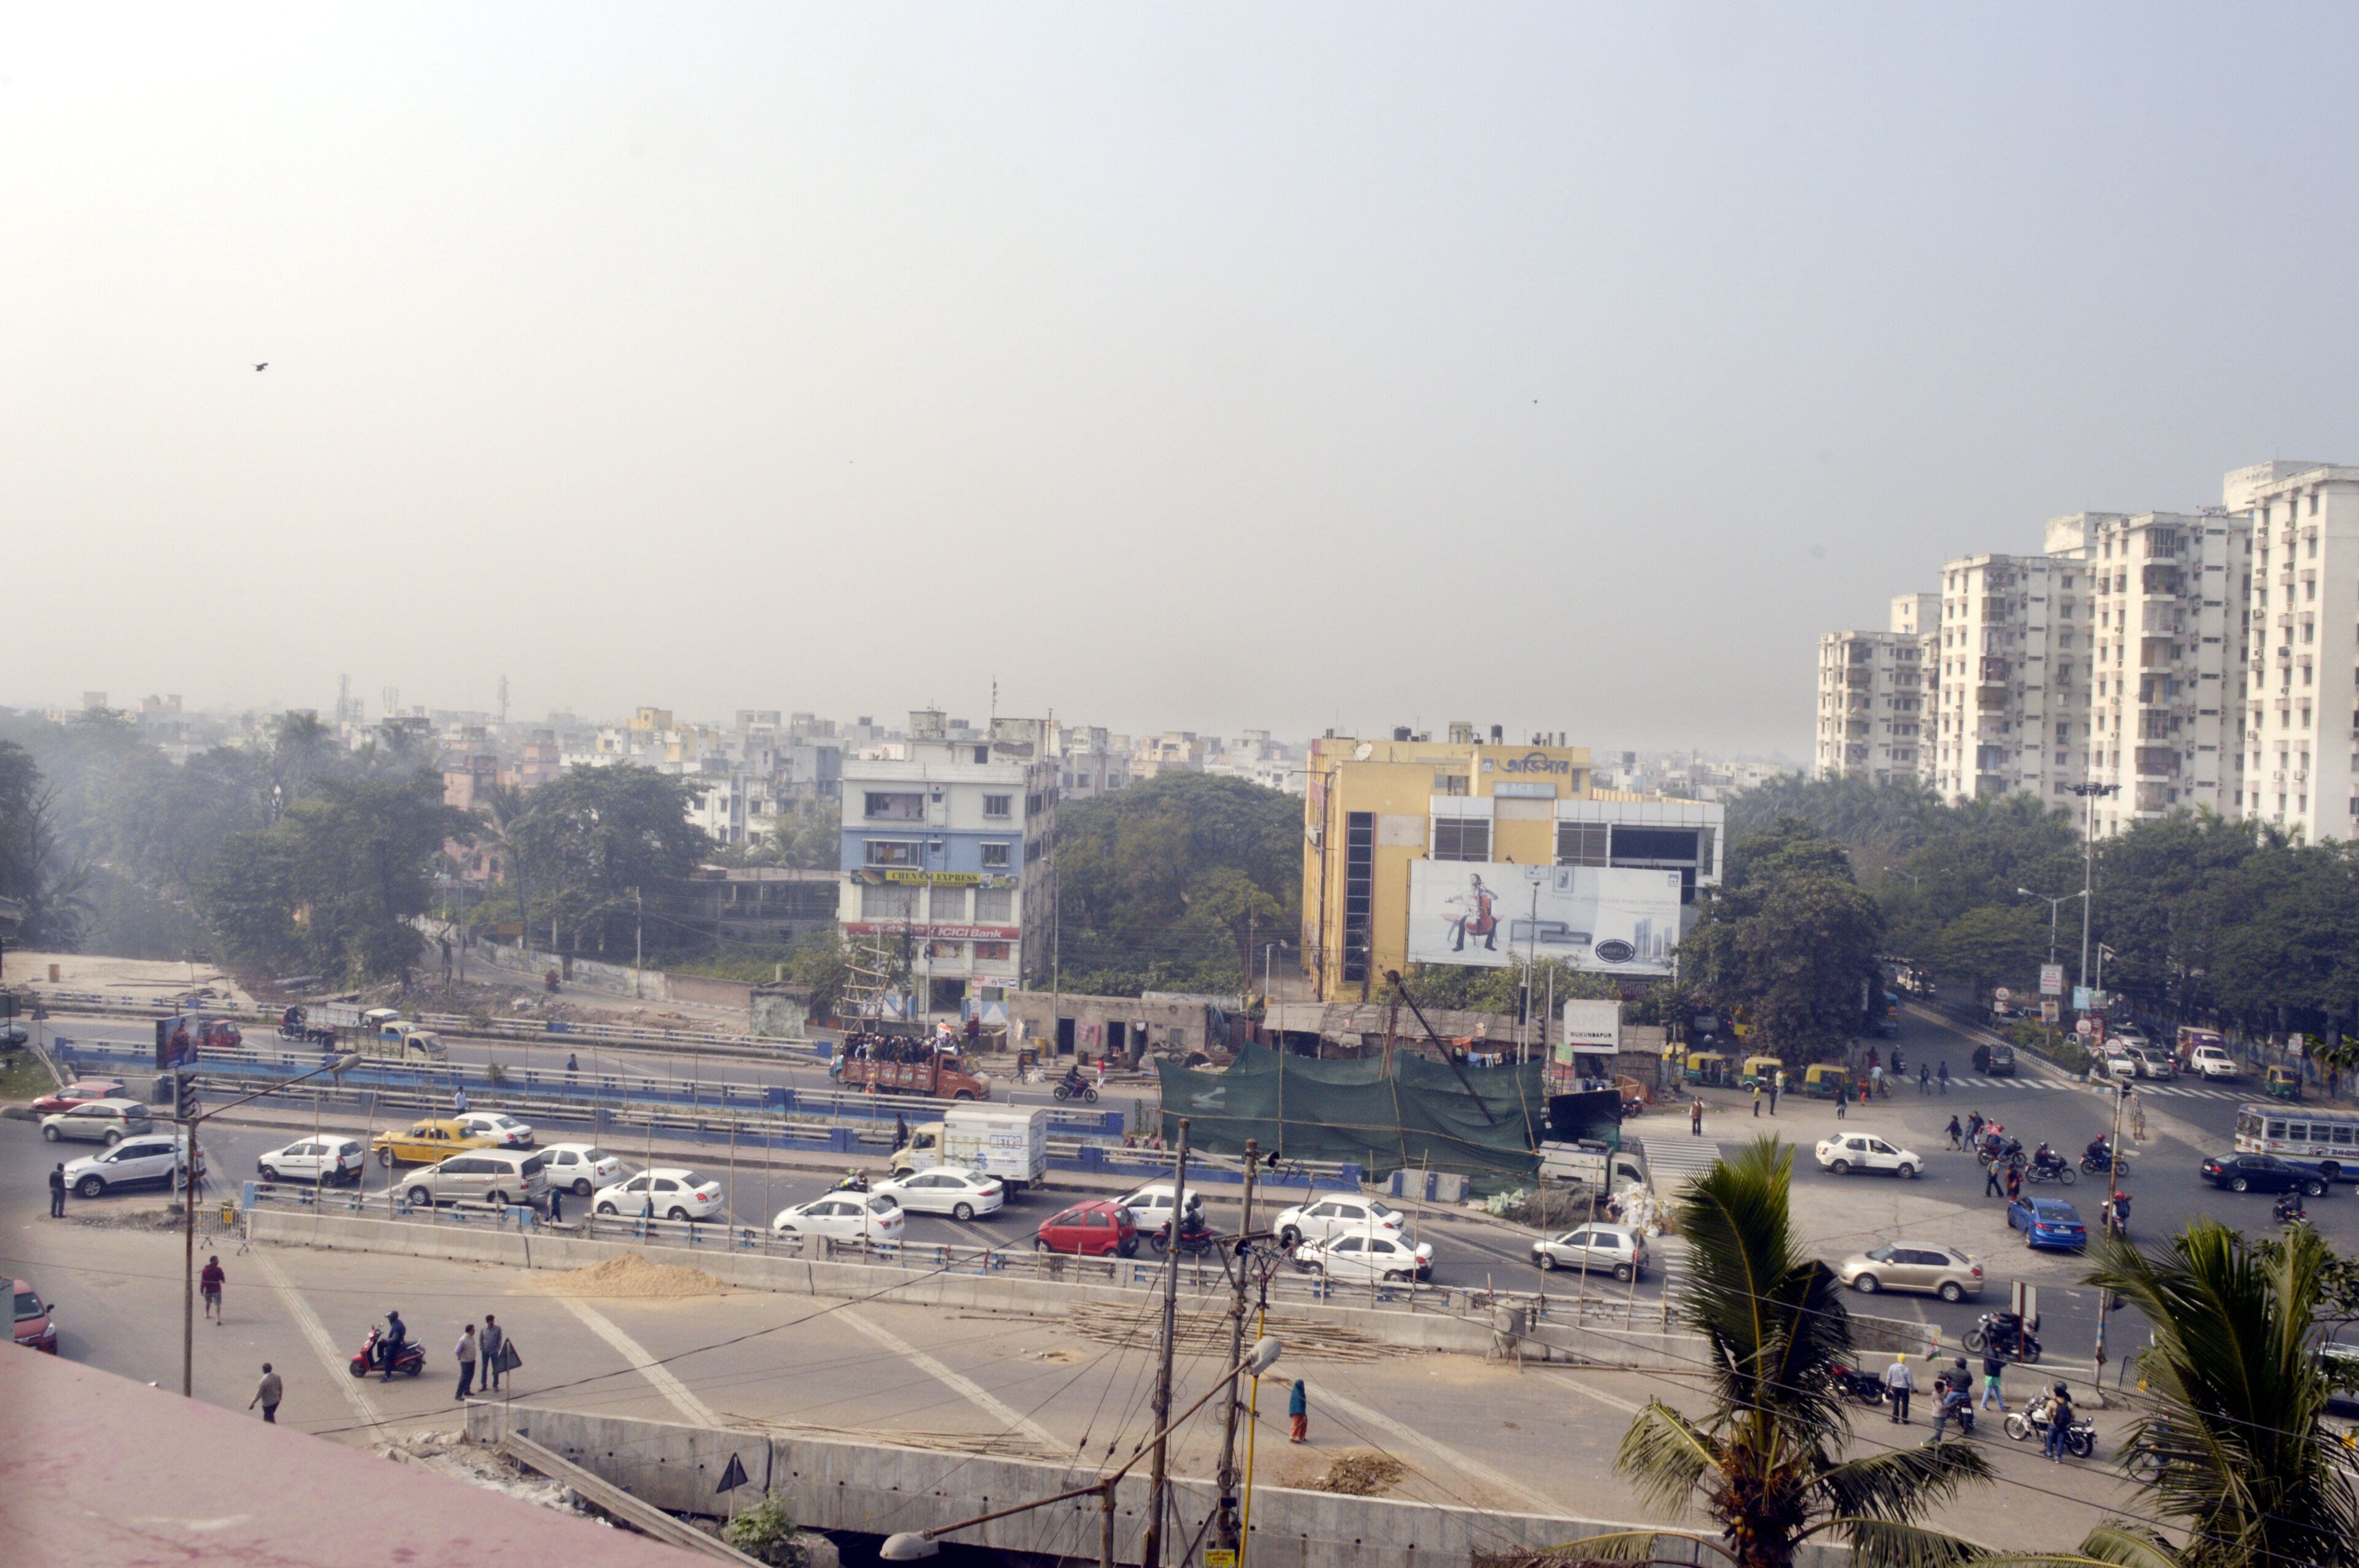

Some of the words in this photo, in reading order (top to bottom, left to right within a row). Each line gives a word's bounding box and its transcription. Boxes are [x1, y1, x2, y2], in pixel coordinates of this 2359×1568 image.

[938, 927, 969, 937] ICICI
[970, 929, 1002, 938] Bank
[989, 1134, 1022, 1149] METRO
